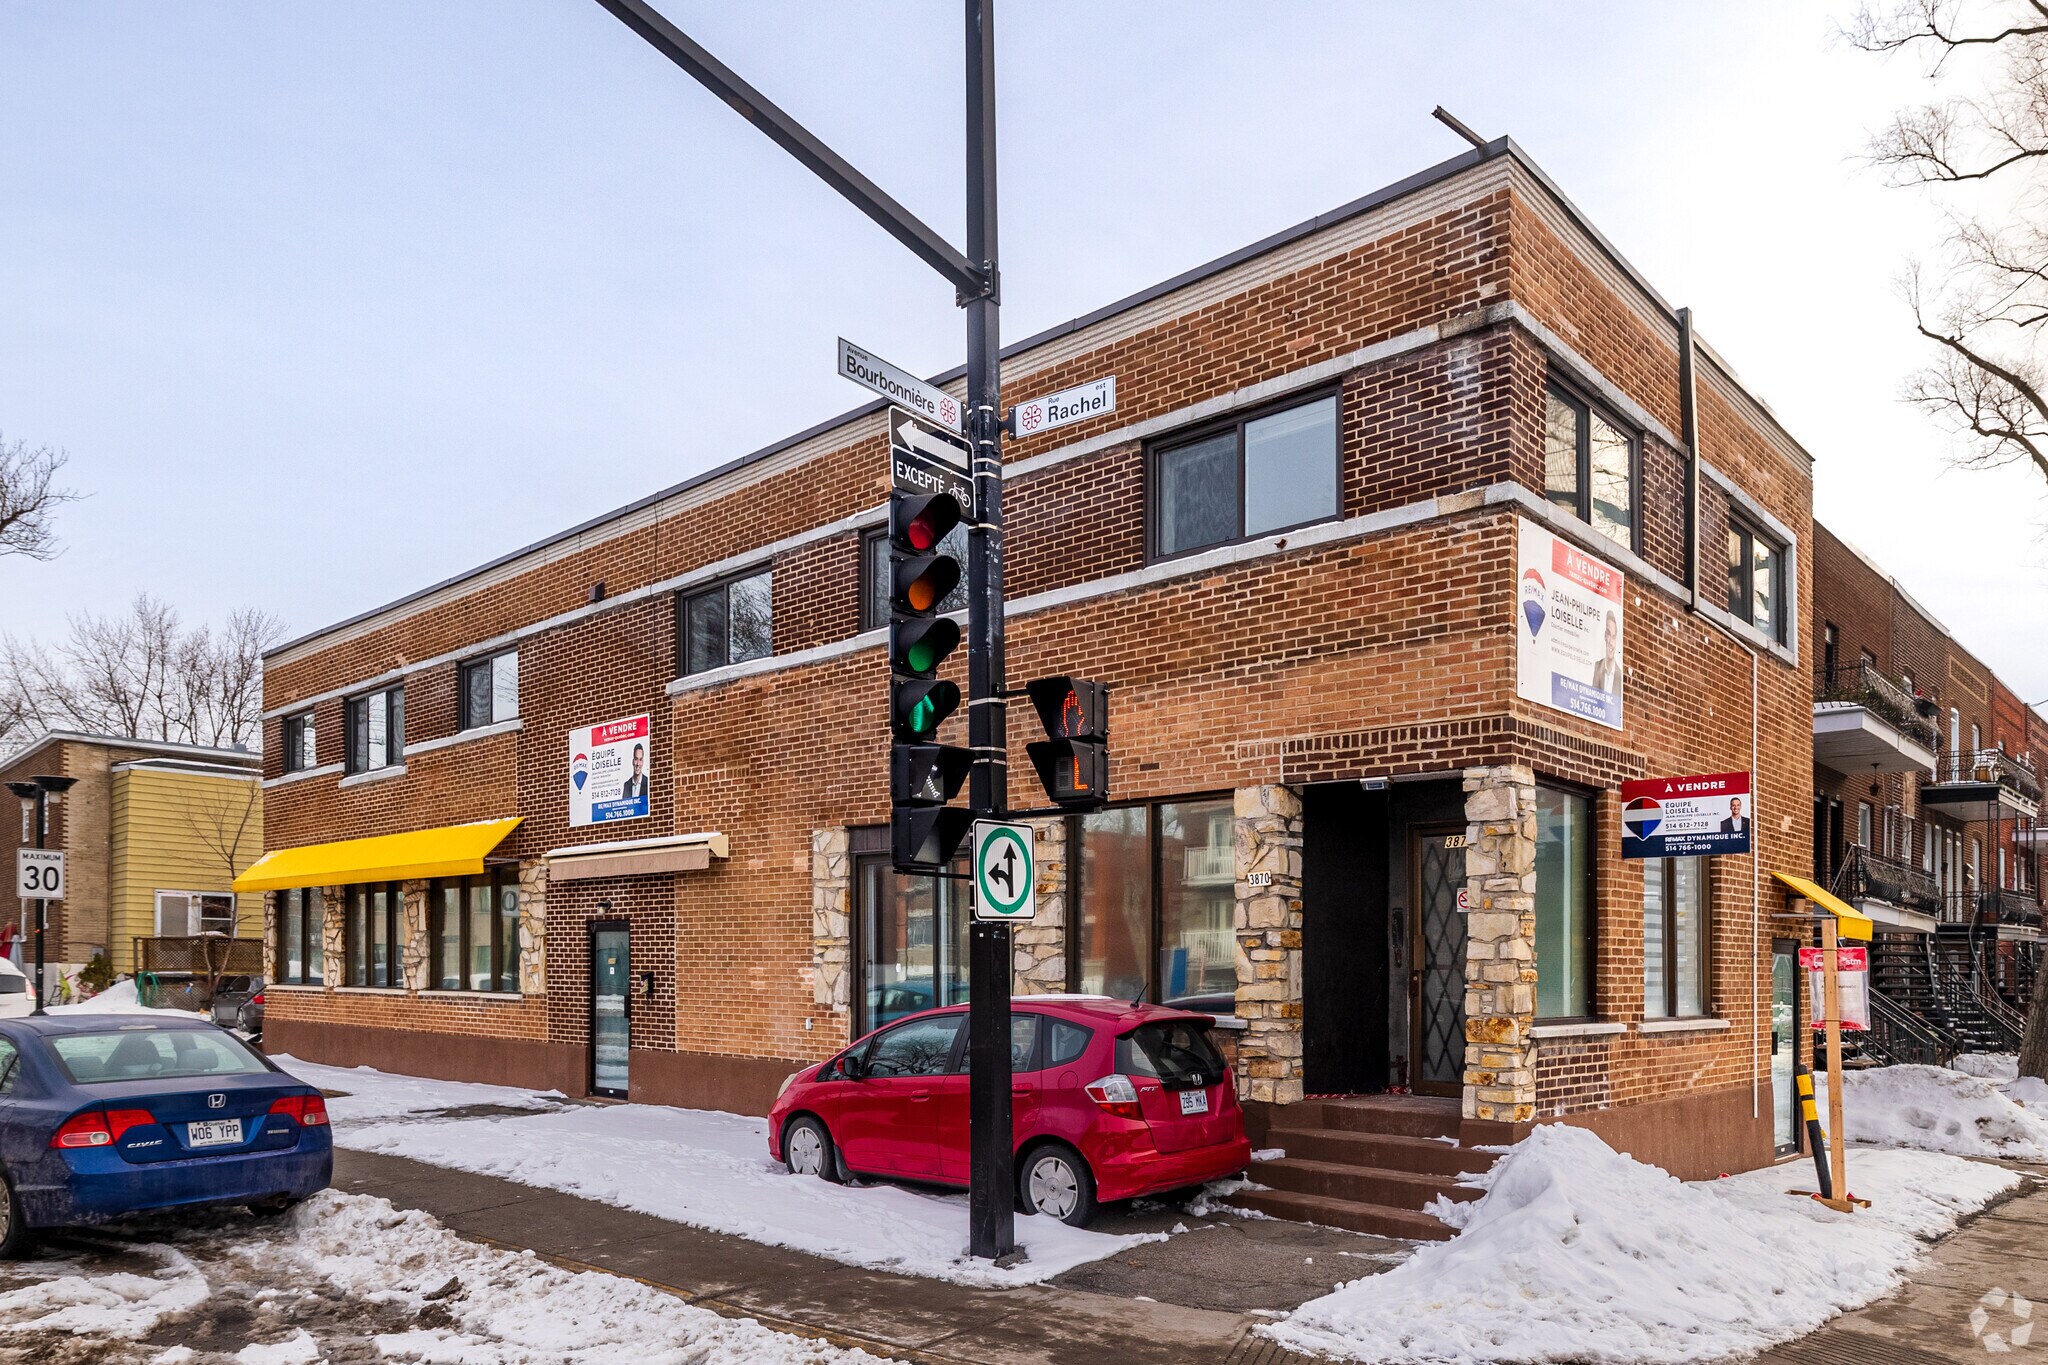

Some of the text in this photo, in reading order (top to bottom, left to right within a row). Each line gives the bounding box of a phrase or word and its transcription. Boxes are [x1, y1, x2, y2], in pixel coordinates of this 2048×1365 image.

[847, 345, 869, 361] Avenue
[846, 354, 935, 414] Bourbonnière
[1095, 382, 1106, 391] est
[1047, 397, 1060, 405] Rue
[1048, 390, 1106, 423] Rachel
[896, 460, 945, 494] EXCEPTÉ
[1576, 557, 1611, 587] VENDRE
[1551, 589, 1600, 622] JEAN-PHILIPPE
[1551, 606, 1583, 631] LOISELLE
[1560, 678, 1579, 693] RE/MAX
[1570, 698, 1606, 719] 514.766.1000
[602, 721, 637, 737] À VENDRE
[591, 757, 622, 771] LOISELLE
[1665, 780, 1726, 793] À VENDRE
[591, 791, 600, 799] 514
[1665, 807, 1699, 815] LOISELLE
[1679, 821, 1709, 829] 612-7128
[1445, 836, 1466, 848] 387
[1686, 833, 1729, 841] DYNAMIQUE
[1678, 843, 1712, 851] 766-1000
[22, 853, 61, 861] MAXIMUM
[23, 865, 60, 891] 30
[1249, 872, 1270, 885] 3870
[190, 1124, 240, 1141] W06 YPP
